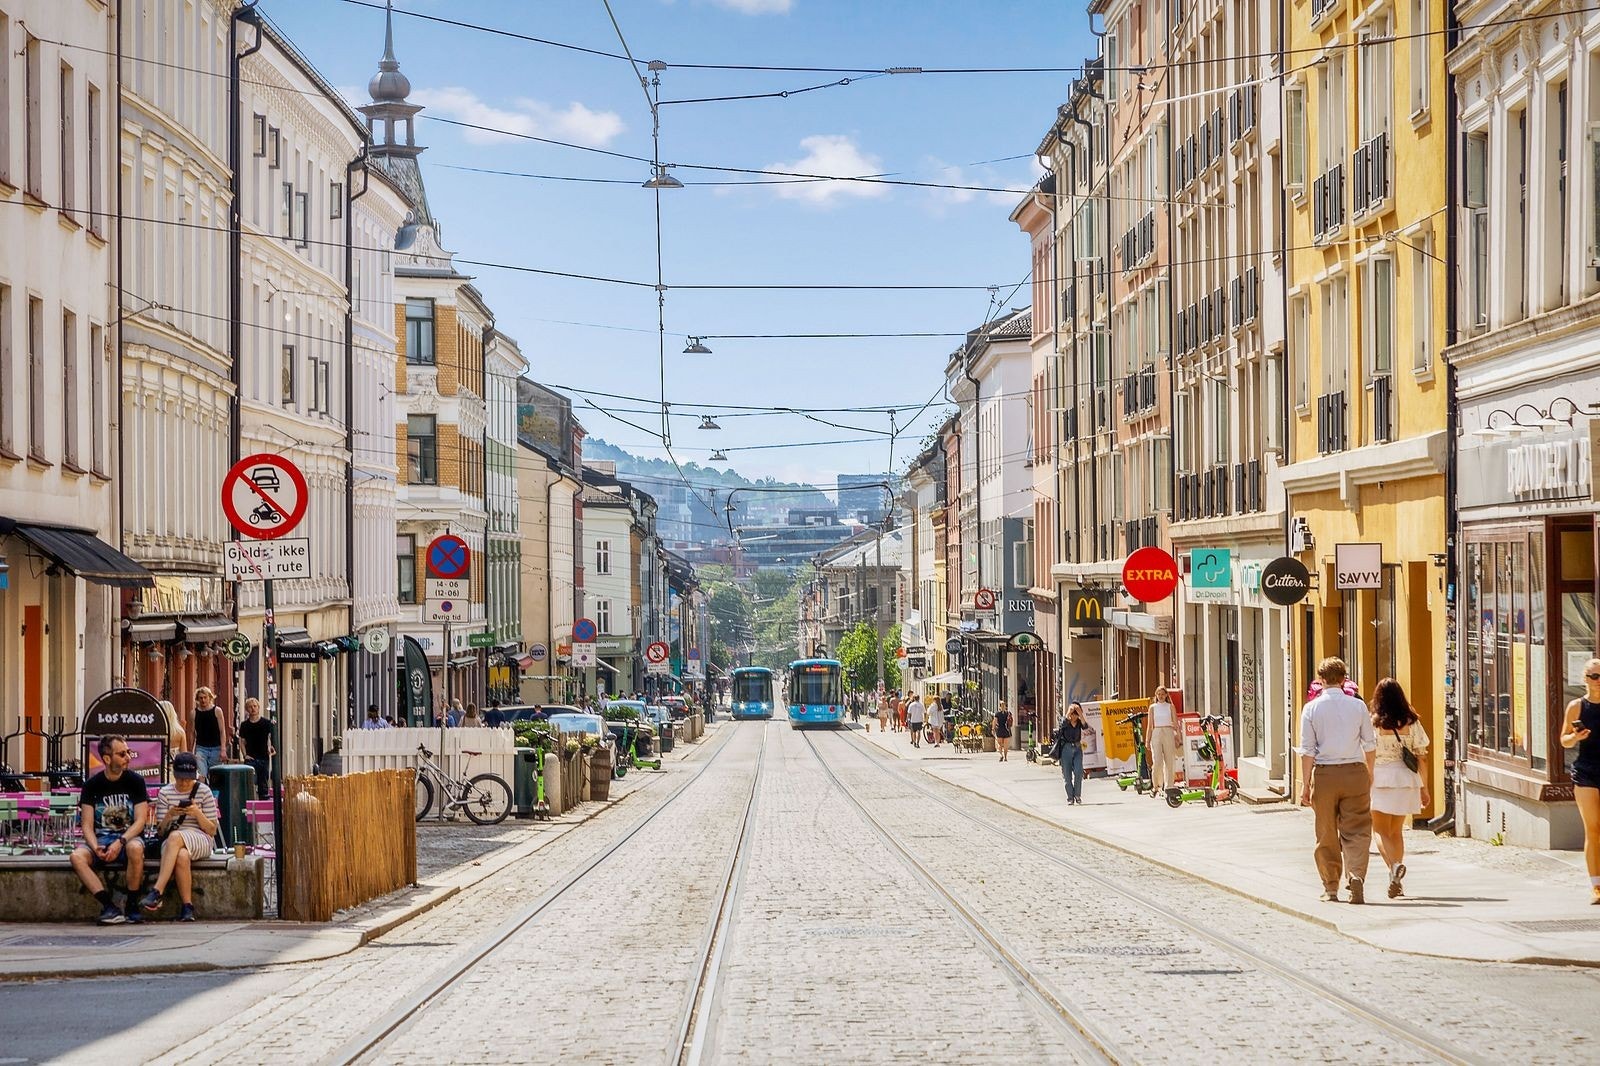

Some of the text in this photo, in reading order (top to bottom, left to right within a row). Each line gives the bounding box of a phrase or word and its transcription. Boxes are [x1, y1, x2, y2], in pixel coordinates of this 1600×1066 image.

[279, 545, 305, 556] ikke
[232, 561, 303, 574] buss i rute
[1126, 569, 1174, 581] EXTRA
[1265, 573, 1307, 588] Cutters.
[1339, 572, 1381, 584] SAVVY.
[1009, 599, 1034, 611] RIST
[1027, 616, 1034, 627] &
[98, 713, 155, 724] LOS TACOS
